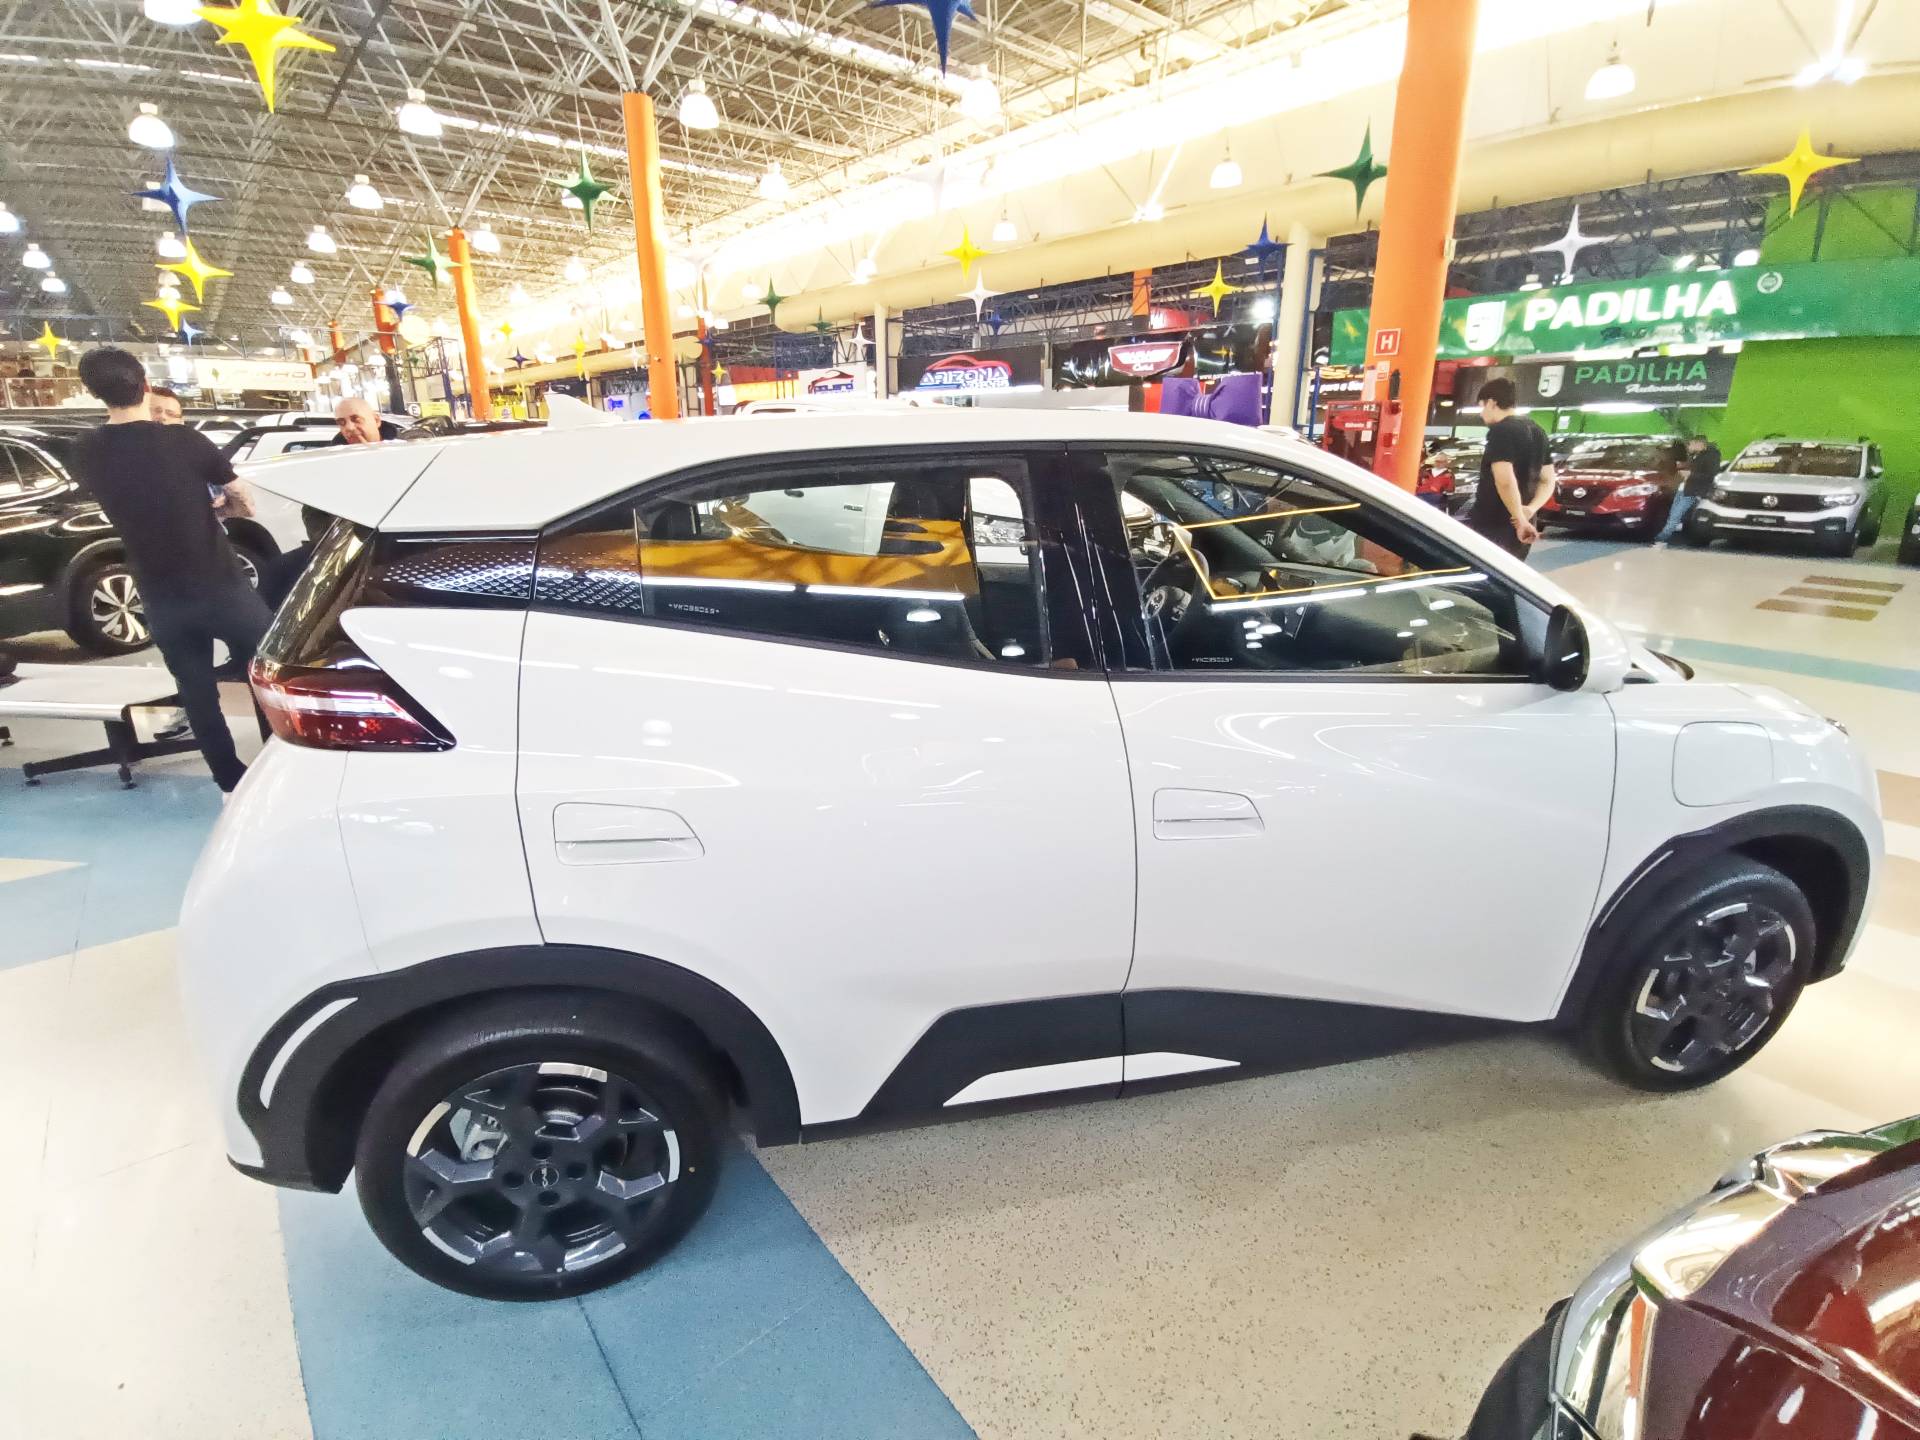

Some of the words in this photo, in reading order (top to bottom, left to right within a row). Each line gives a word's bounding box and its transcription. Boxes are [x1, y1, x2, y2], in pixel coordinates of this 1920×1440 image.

[1524, 281, 1737, 331] PADILHA
[1381, 335, 1393, 350] H
[919, 366, 1009, 386] ARIZONA
[1574, 360, 1708, 385] PADILHA
